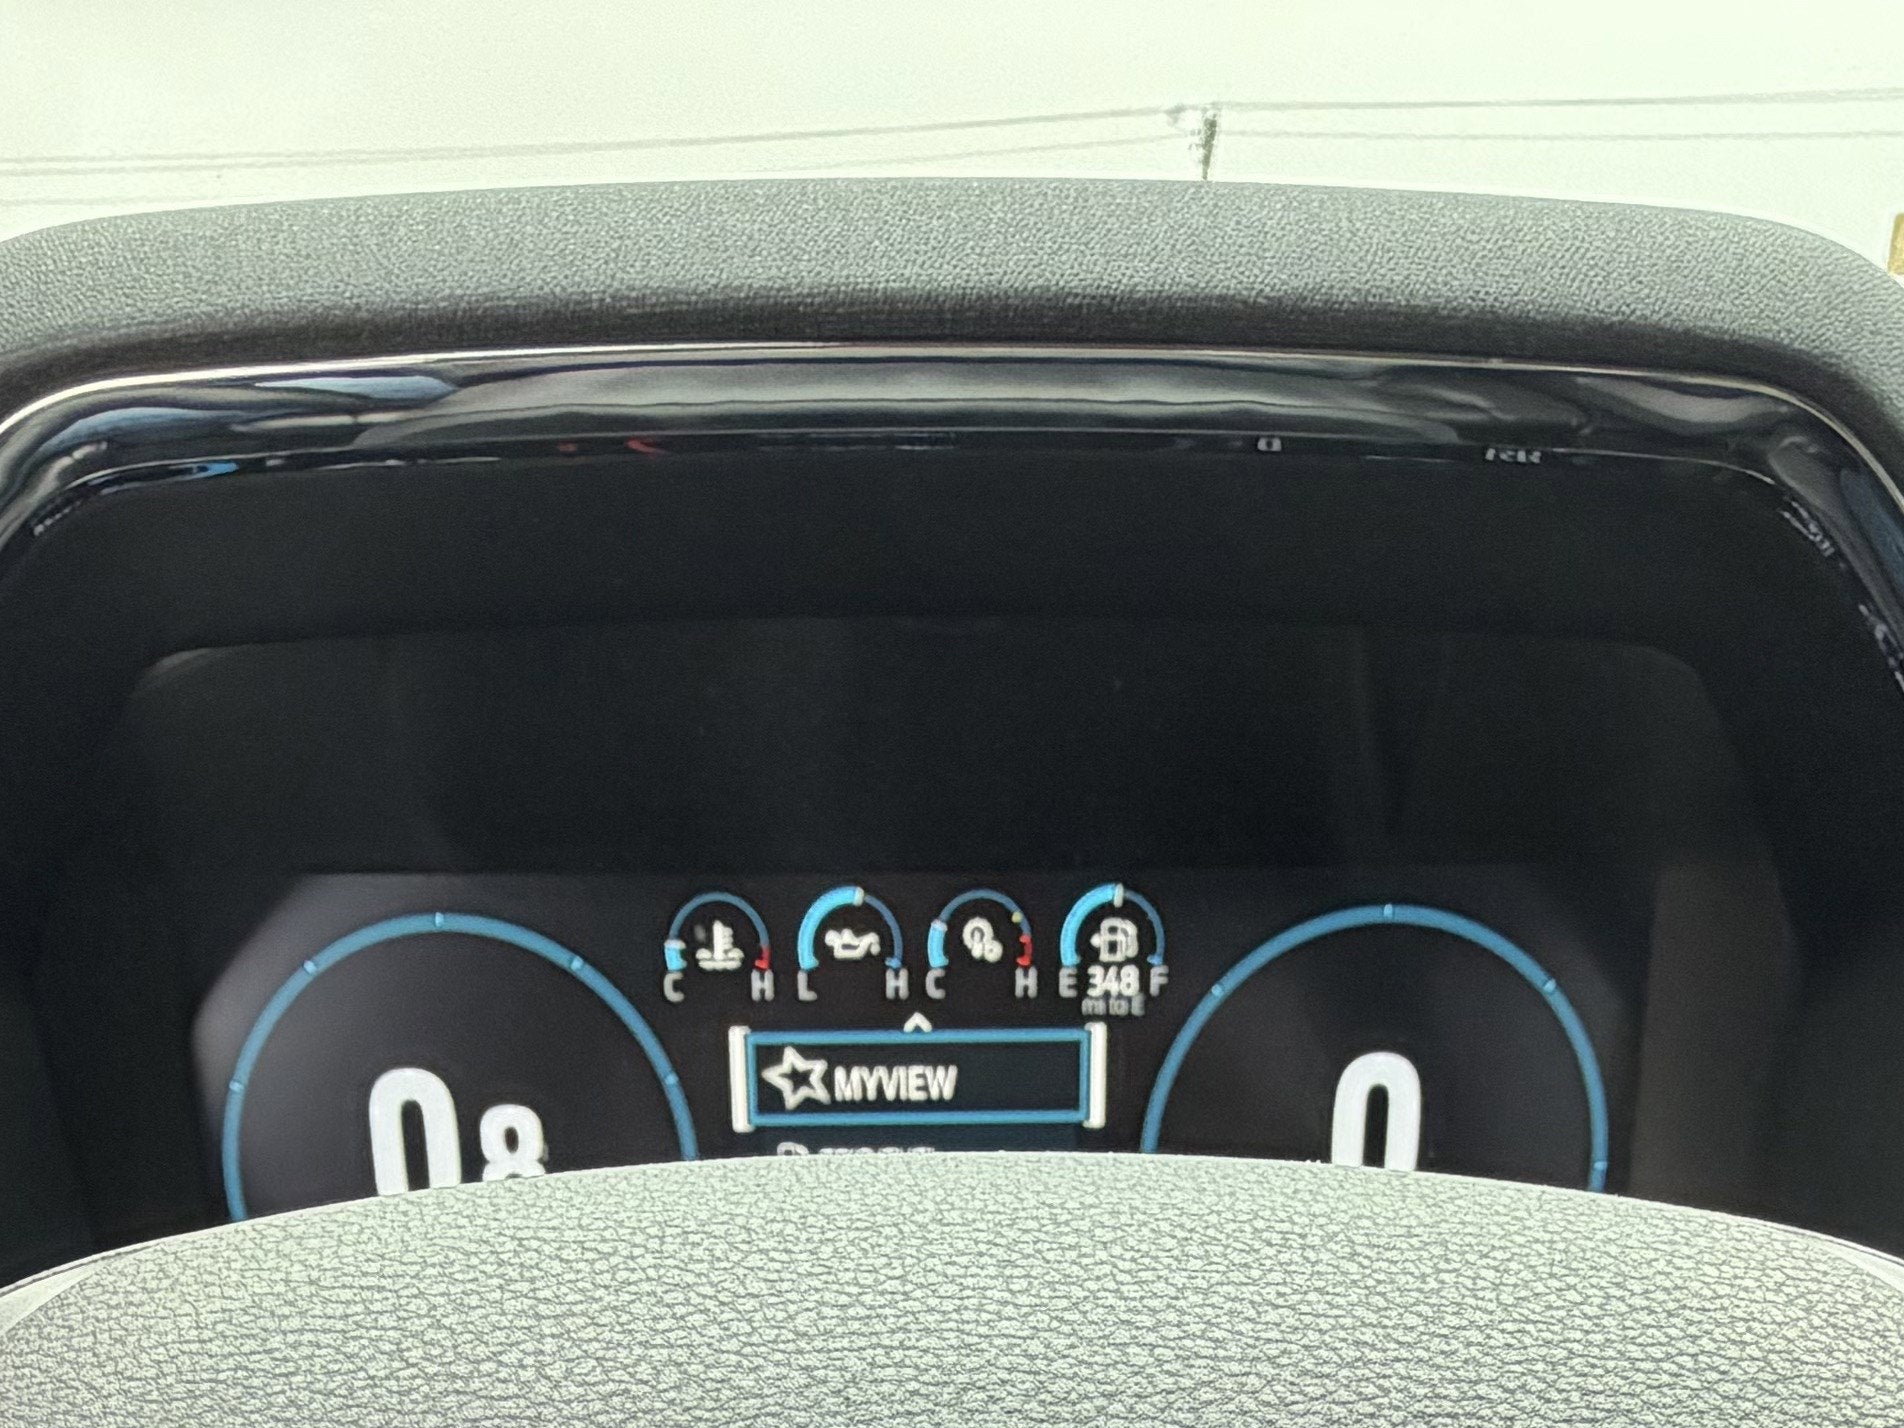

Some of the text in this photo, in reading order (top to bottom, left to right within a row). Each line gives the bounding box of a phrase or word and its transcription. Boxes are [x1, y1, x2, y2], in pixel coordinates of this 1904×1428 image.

[664, 971, 685, 1001] C
[751, 969, 775, 1001] H
[797, 970, 817, 1001] L
[885, 968, 910, 1000] H
[925, 969, 946, 999] C
[1015, 966, 1038, 998] H
[1058, 966, 1079, 998] E
[1086, 964, 1141, 998] 348
[1149, 965, 1170, 997] F
[833, 1064, 959, 1102] MYVIEW
